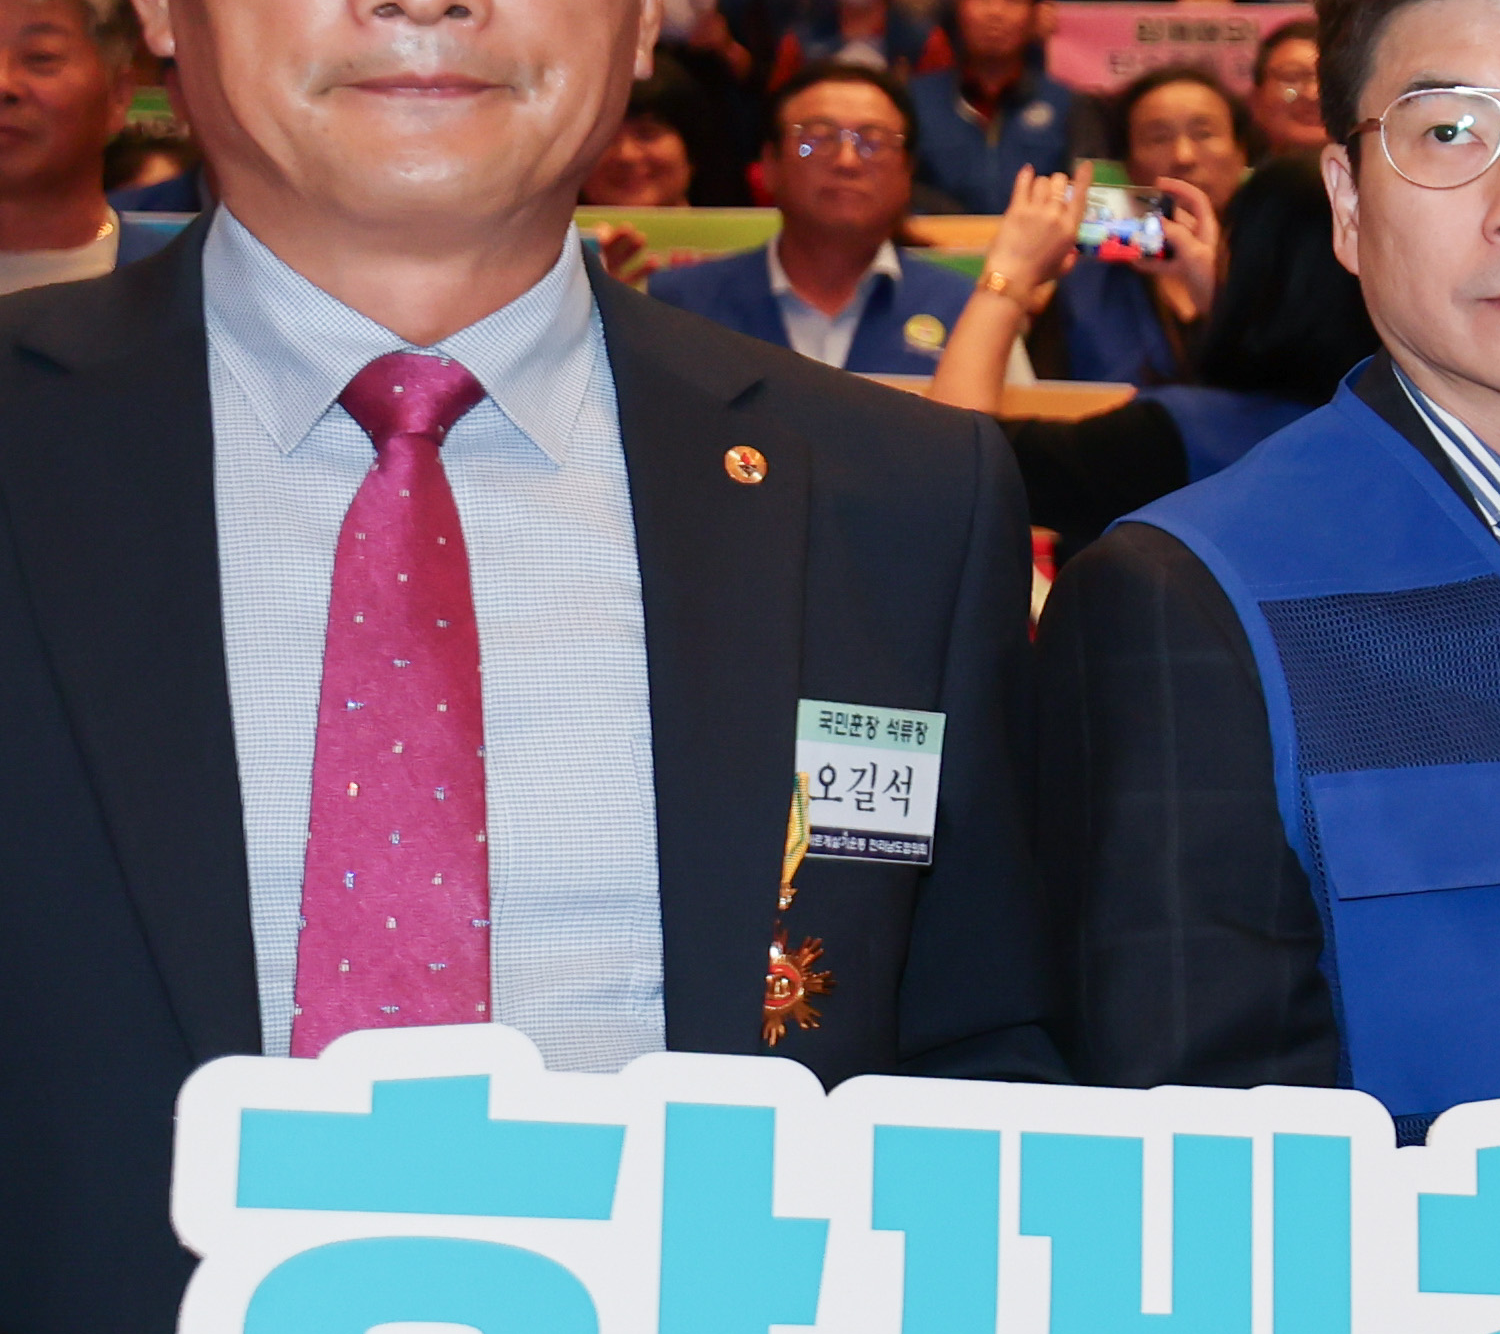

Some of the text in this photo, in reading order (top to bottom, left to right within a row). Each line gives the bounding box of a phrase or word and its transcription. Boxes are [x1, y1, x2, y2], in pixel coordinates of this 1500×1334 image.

[818, 709, 929, 747] 국민훈장 석류장
[808, 760, 914, 818] 오길석
